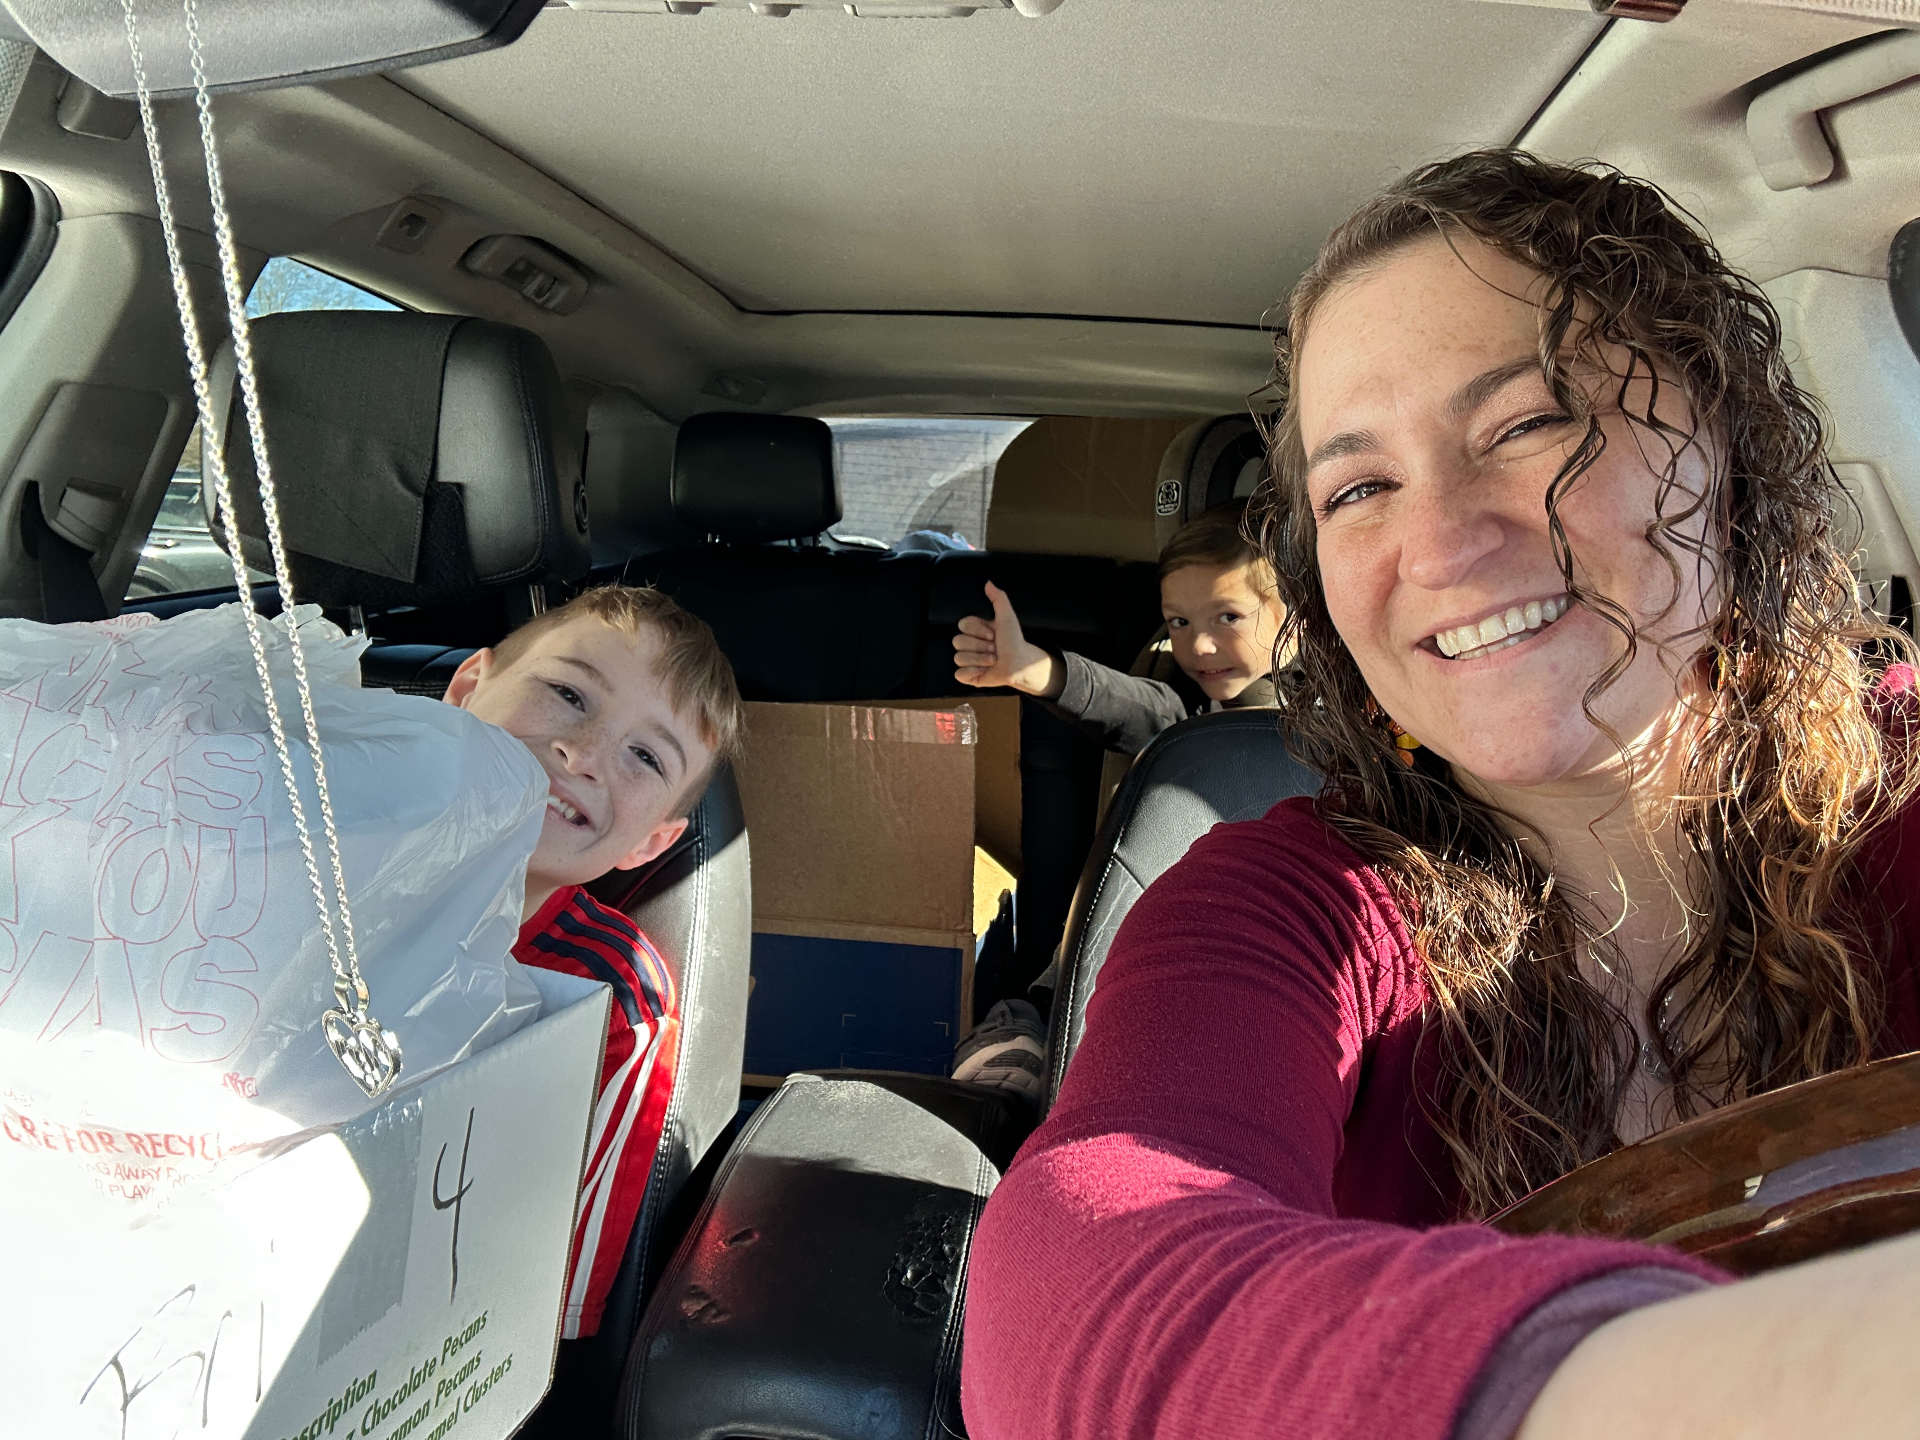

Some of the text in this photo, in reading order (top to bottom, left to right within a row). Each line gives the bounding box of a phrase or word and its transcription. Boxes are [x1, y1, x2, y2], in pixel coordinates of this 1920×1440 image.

[114, 1163, 161, 1181] AWAY
[432, 1106, 474, 1305] 4
[361, 1310, 488, 1437] Chocolate Pecans
[433, 1350, 482, 1409] Pecans
[462, 1352, 513, 1414] Clusters
